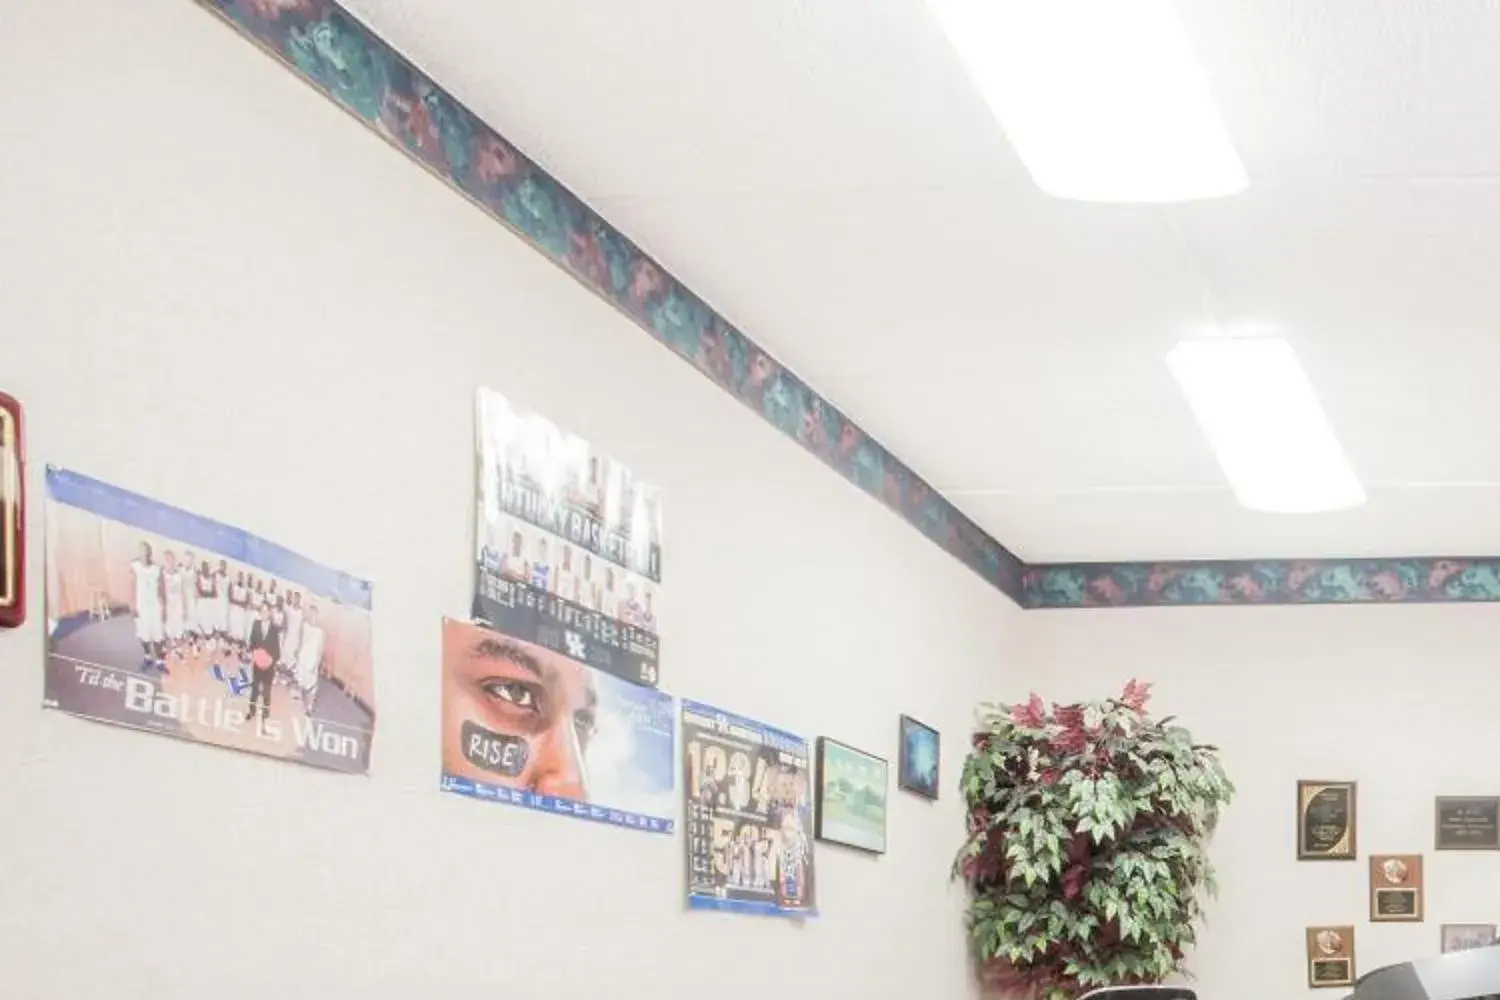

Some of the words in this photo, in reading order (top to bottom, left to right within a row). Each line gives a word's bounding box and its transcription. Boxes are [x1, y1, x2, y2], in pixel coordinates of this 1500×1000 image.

[124, 677, 245, 733] Battle
[292, 717, 358, 759] Won
[469, 733, 518, 767] RISE
